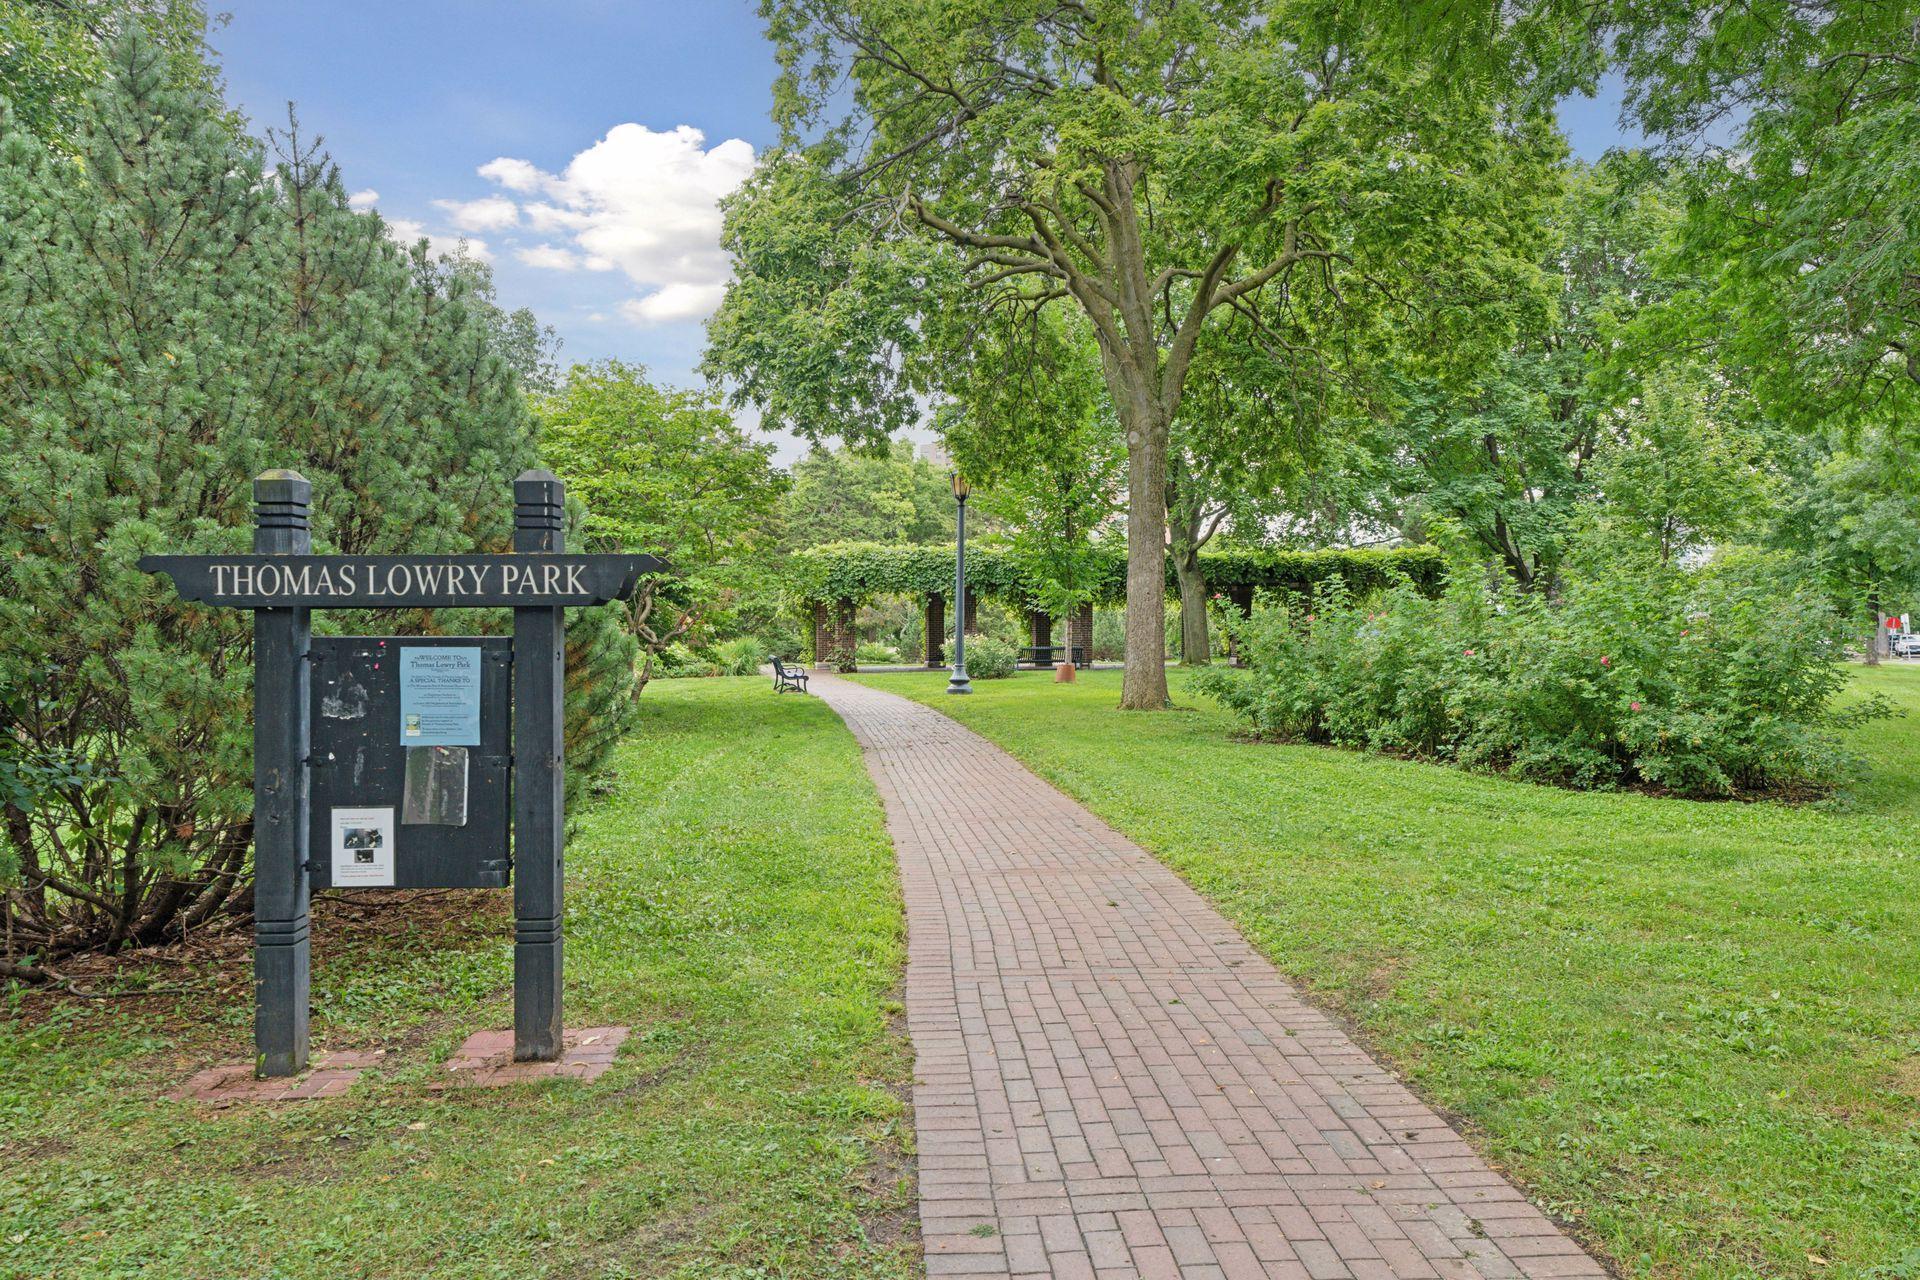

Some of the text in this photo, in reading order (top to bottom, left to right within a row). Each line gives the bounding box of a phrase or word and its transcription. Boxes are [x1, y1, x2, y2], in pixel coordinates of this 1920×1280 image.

[209, 564, 589, 596] THOMAS LOWRY PARK
[436, 661, 455, 669] Lowry
